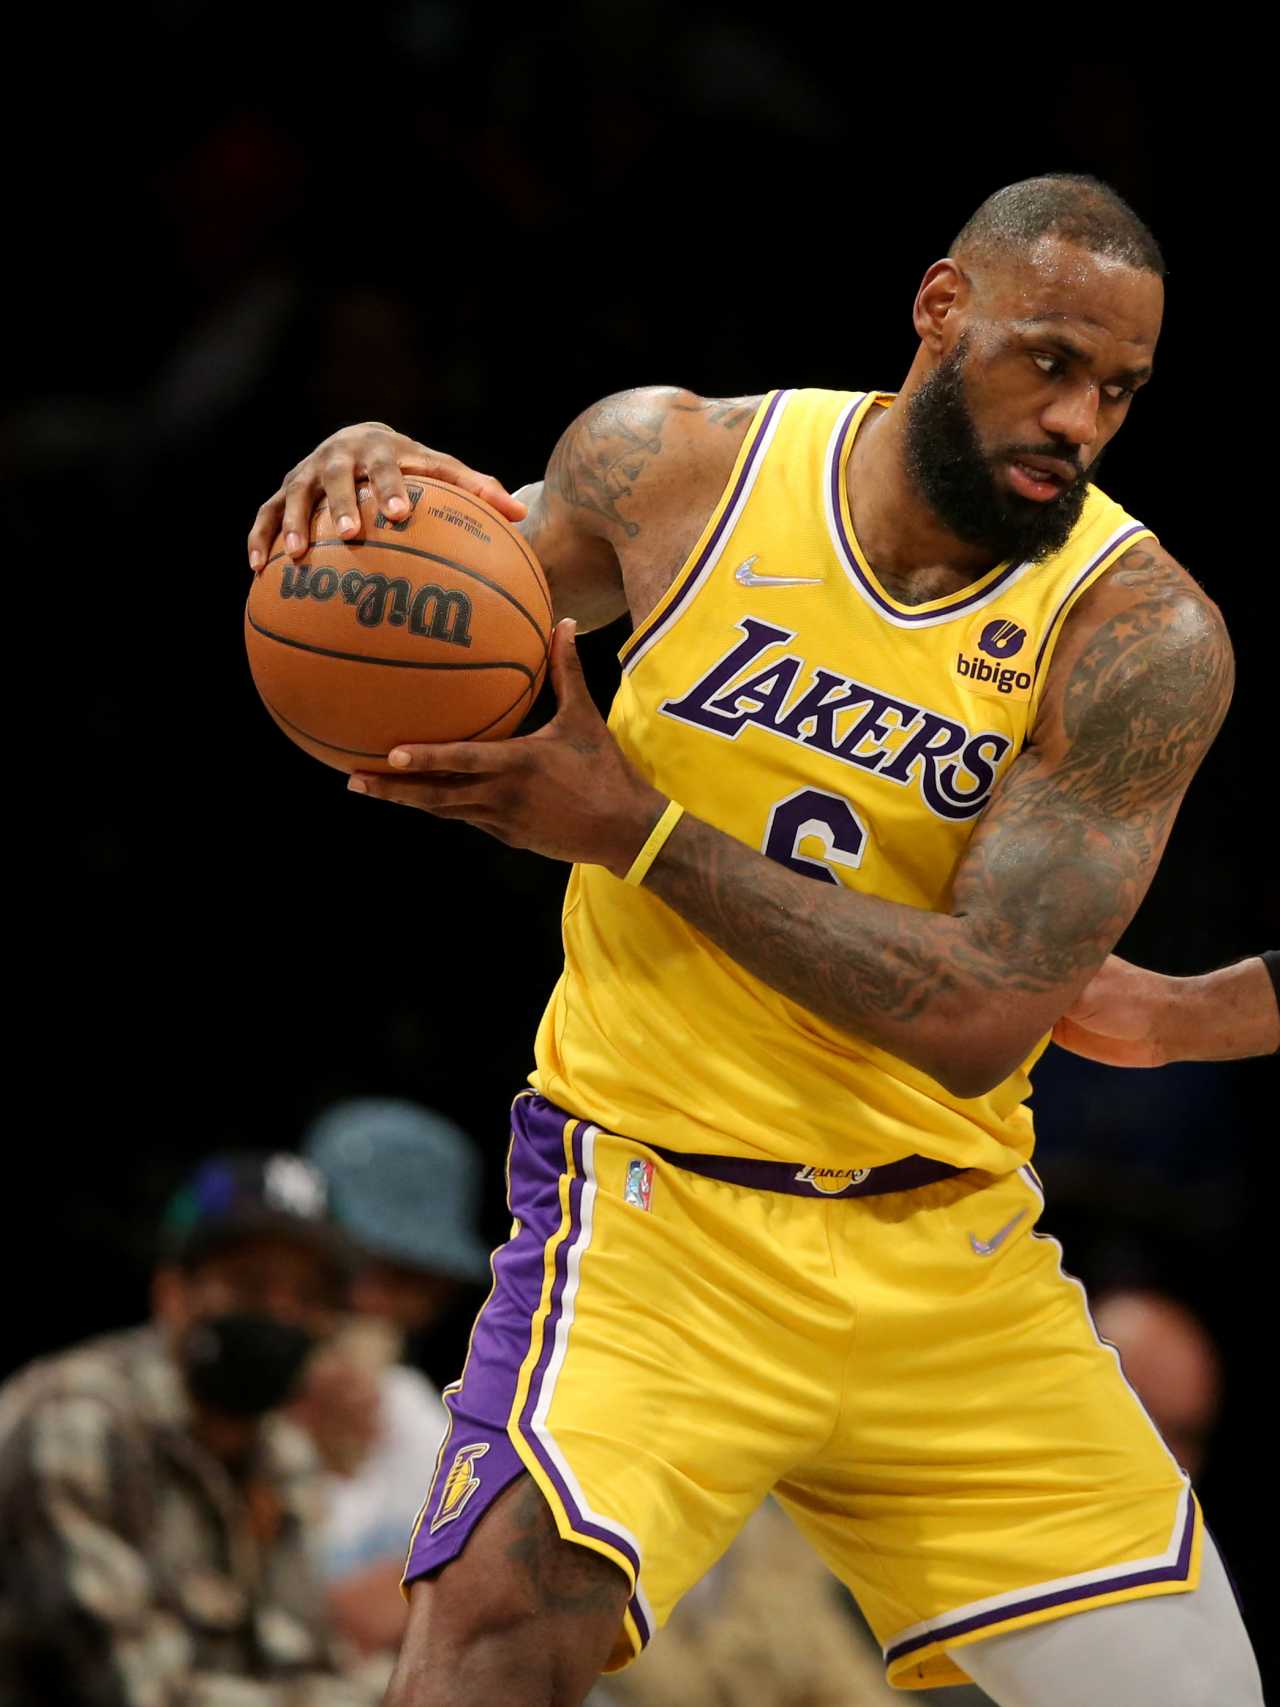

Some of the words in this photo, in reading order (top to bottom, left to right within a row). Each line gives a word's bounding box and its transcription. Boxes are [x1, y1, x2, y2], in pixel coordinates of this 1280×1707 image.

[279, 563, 473, 648] Wilson
[657, 615, 1014, 822] LAKERS
[957, 652, 1031, 694] bibigo
[761, 785, 869, 886] 6
